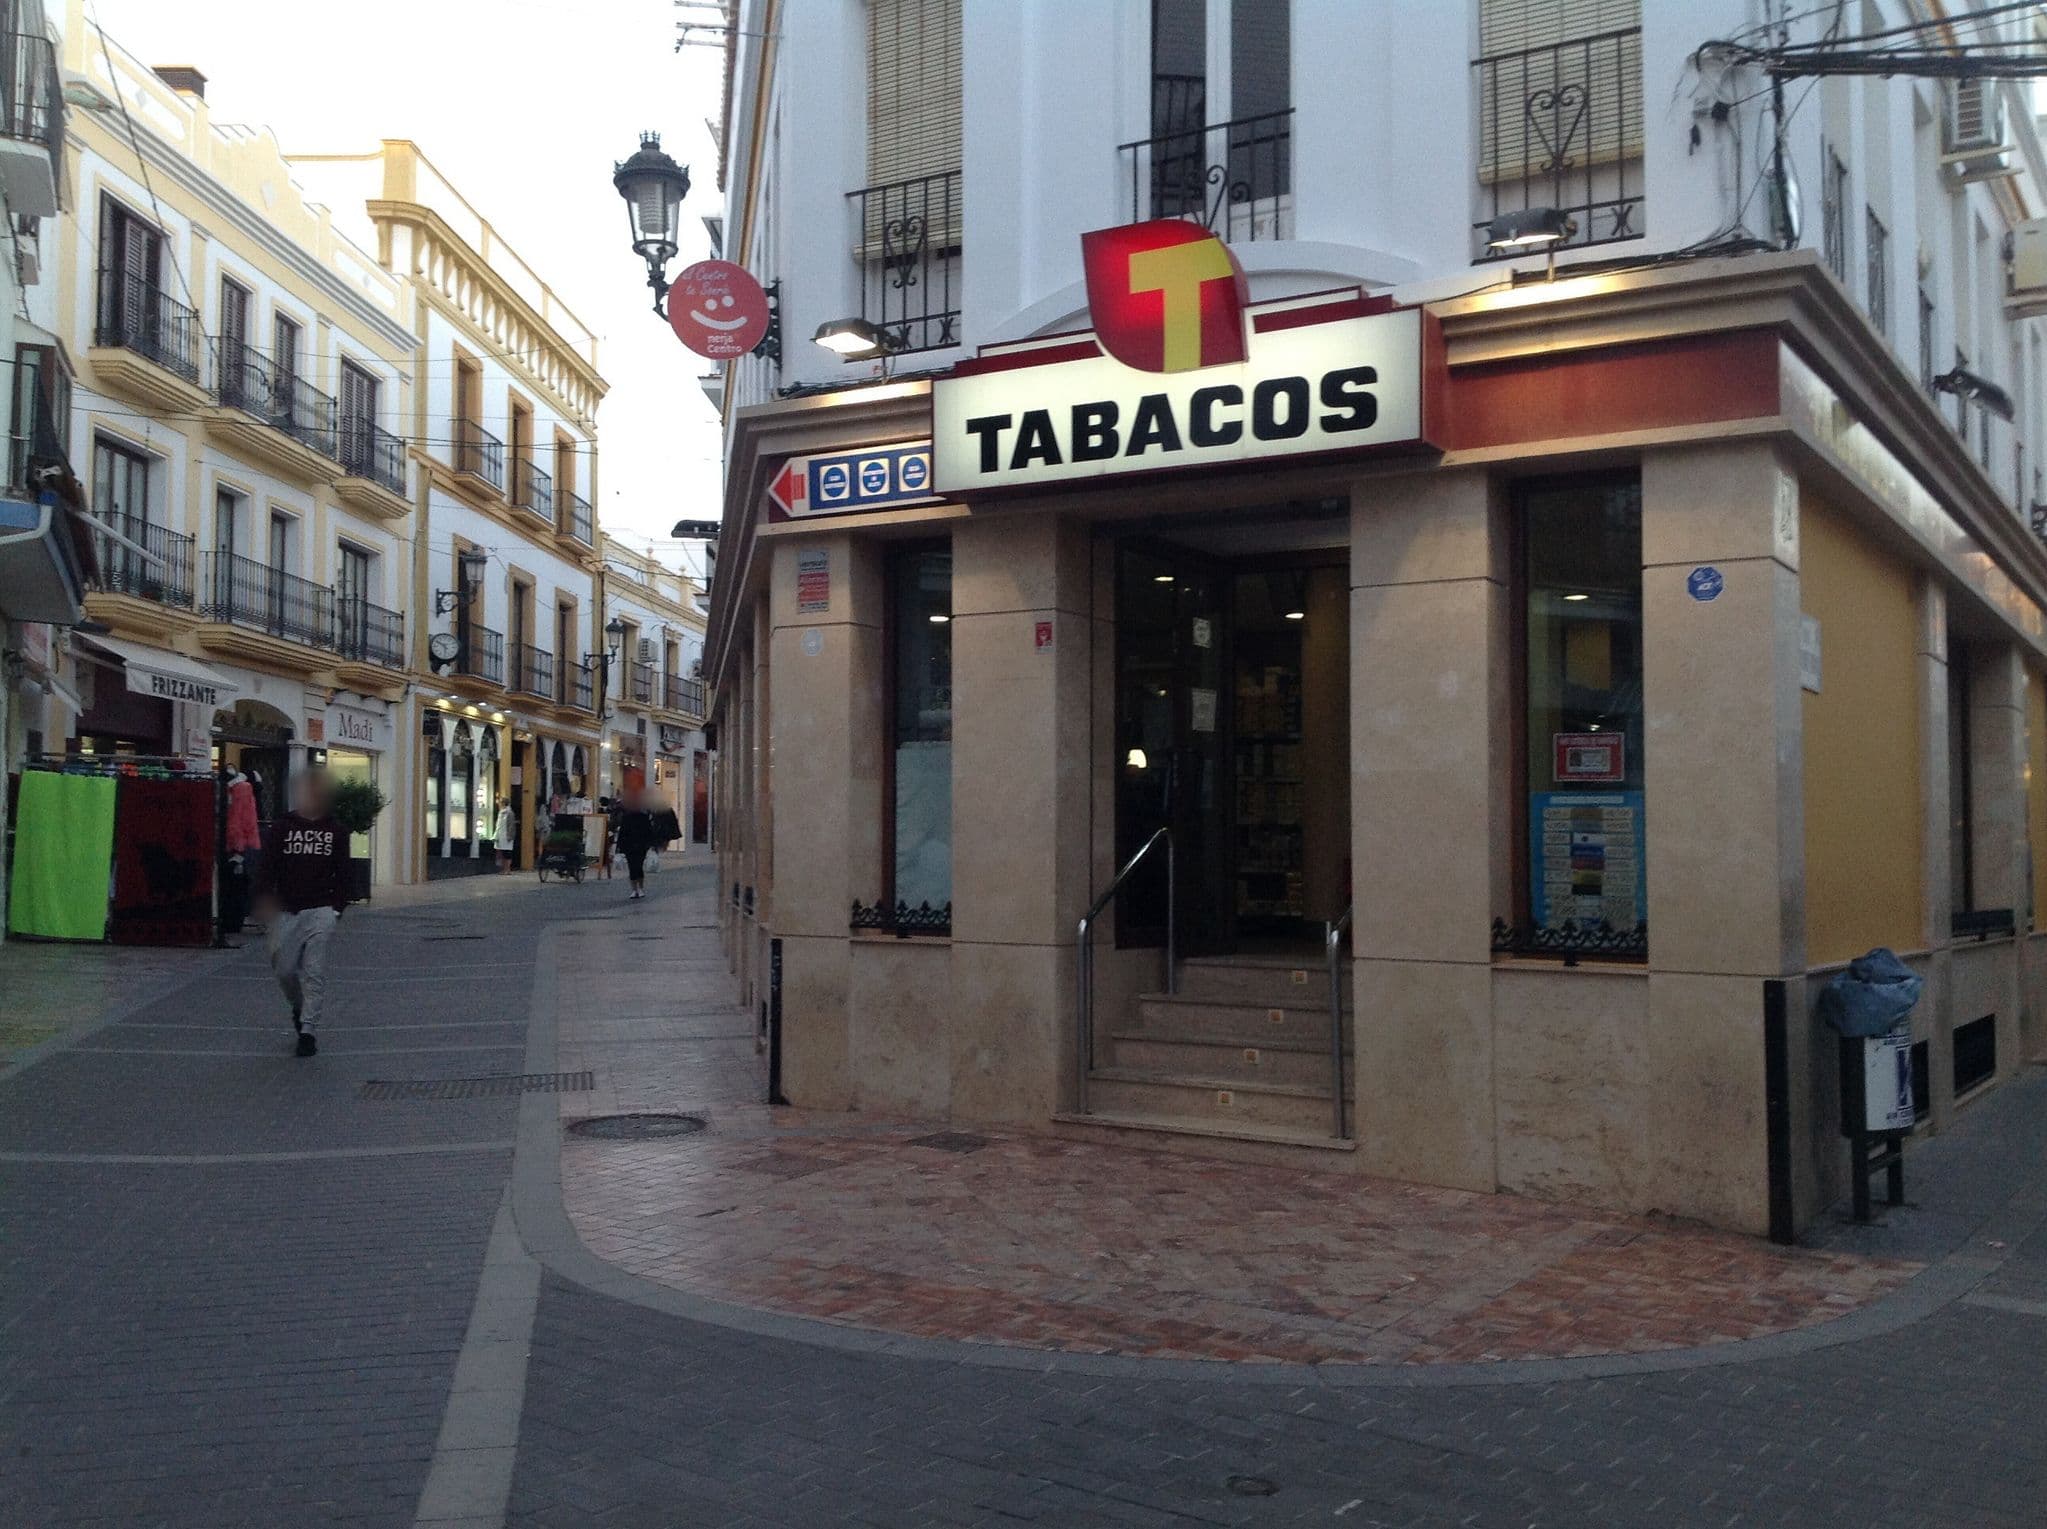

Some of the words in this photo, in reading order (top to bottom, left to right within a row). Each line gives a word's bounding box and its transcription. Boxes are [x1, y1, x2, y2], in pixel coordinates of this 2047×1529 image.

[1129, 237, 1234, 374] T
[966, 365, 1378, 474] TABACOS
[151, 675, 217, 705] FRIZZANTE
[282, 842, 333, 856] JONES
